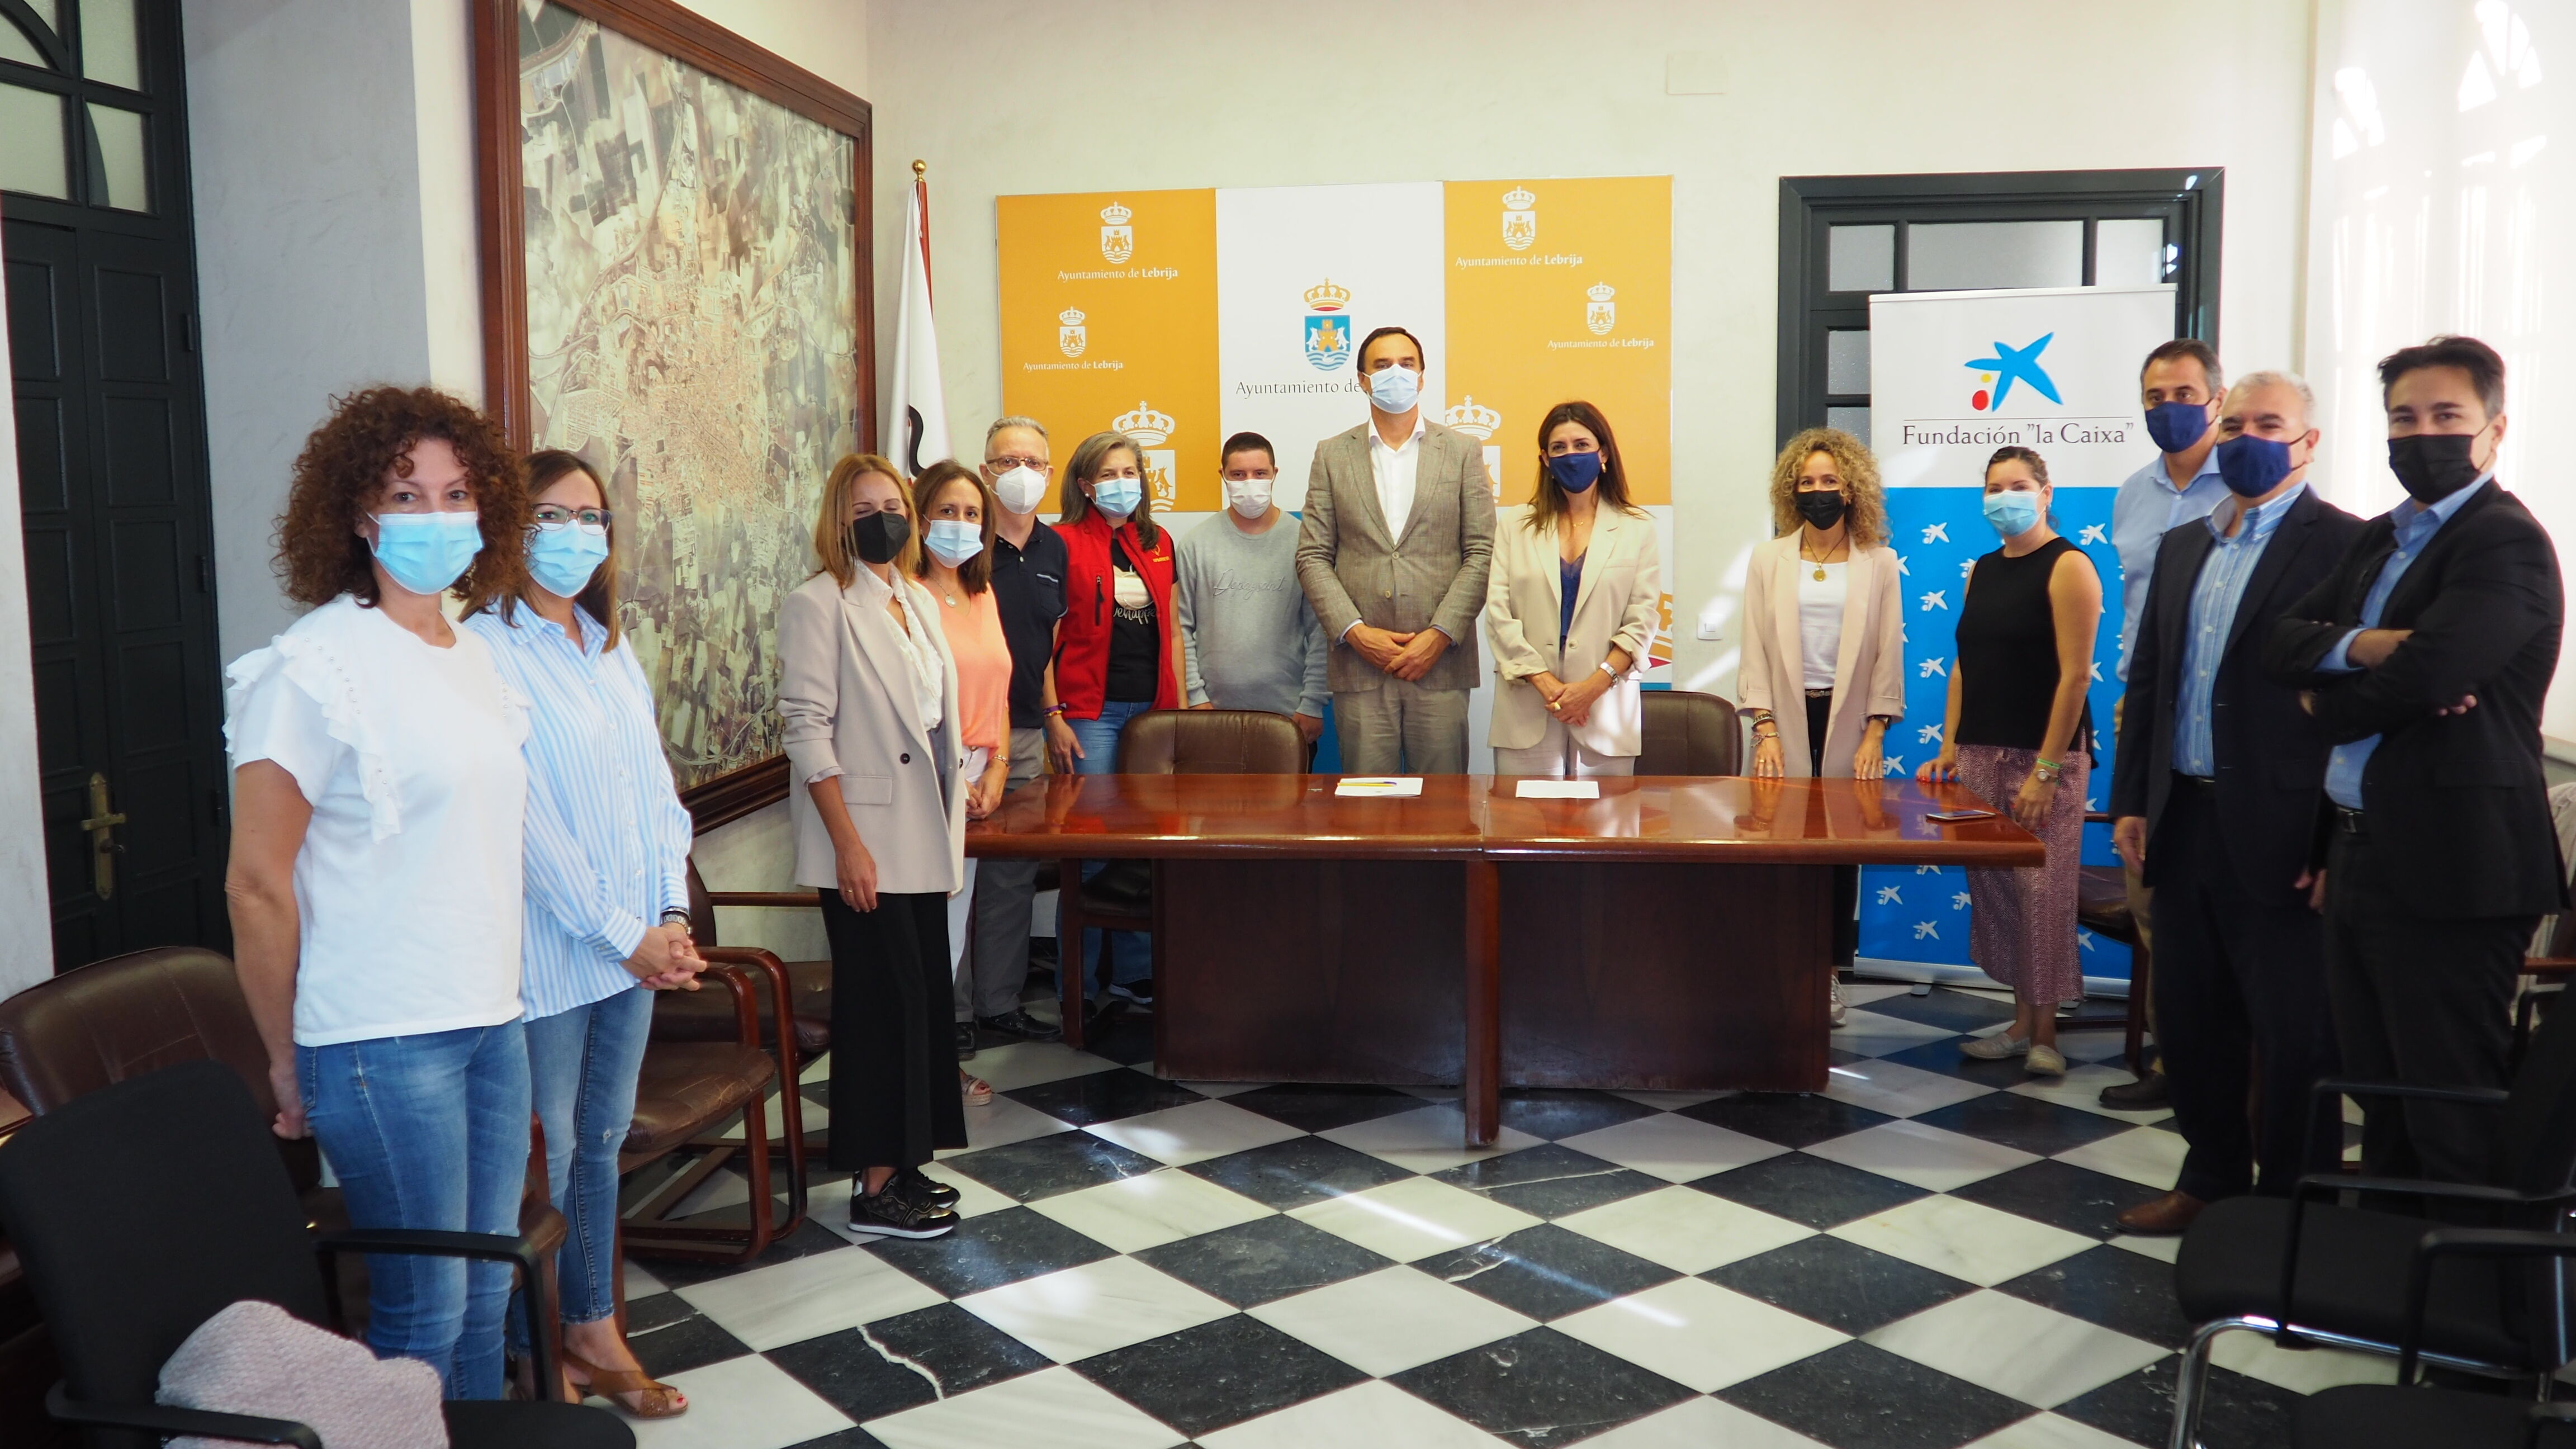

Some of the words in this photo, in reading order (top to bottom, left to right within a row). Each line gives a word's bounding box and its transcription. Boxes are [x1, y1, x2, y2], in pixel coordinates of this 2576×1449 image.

[1455, 256, 1527, 269] Ayuntamiento
[1530, 254, 1542, 265] de
[1544, 254, 1583, 267] Lebrija
[1057, 269, 1125, 281] Ayuntamiento
[1128, 268, 1139, 278] de
[1142, 267, 1178, 280] Lebrija
[1547, 340, 1607, 349] Ayuntamiento
[1609, 338, 1620, 347] de
[1622, 338, 1654, 349] Lebrija
[1023, 362, 1079, 371] Ayuntamiento
[1081, 360, 1092, 370] de
[1093, 360, 1124, 371] Lebrija
[1235, 380, 1339, 399] Ayuntamiento
[1344, 378, 1360, 393] de
[1902, 425, 2021, 446] Fundación
